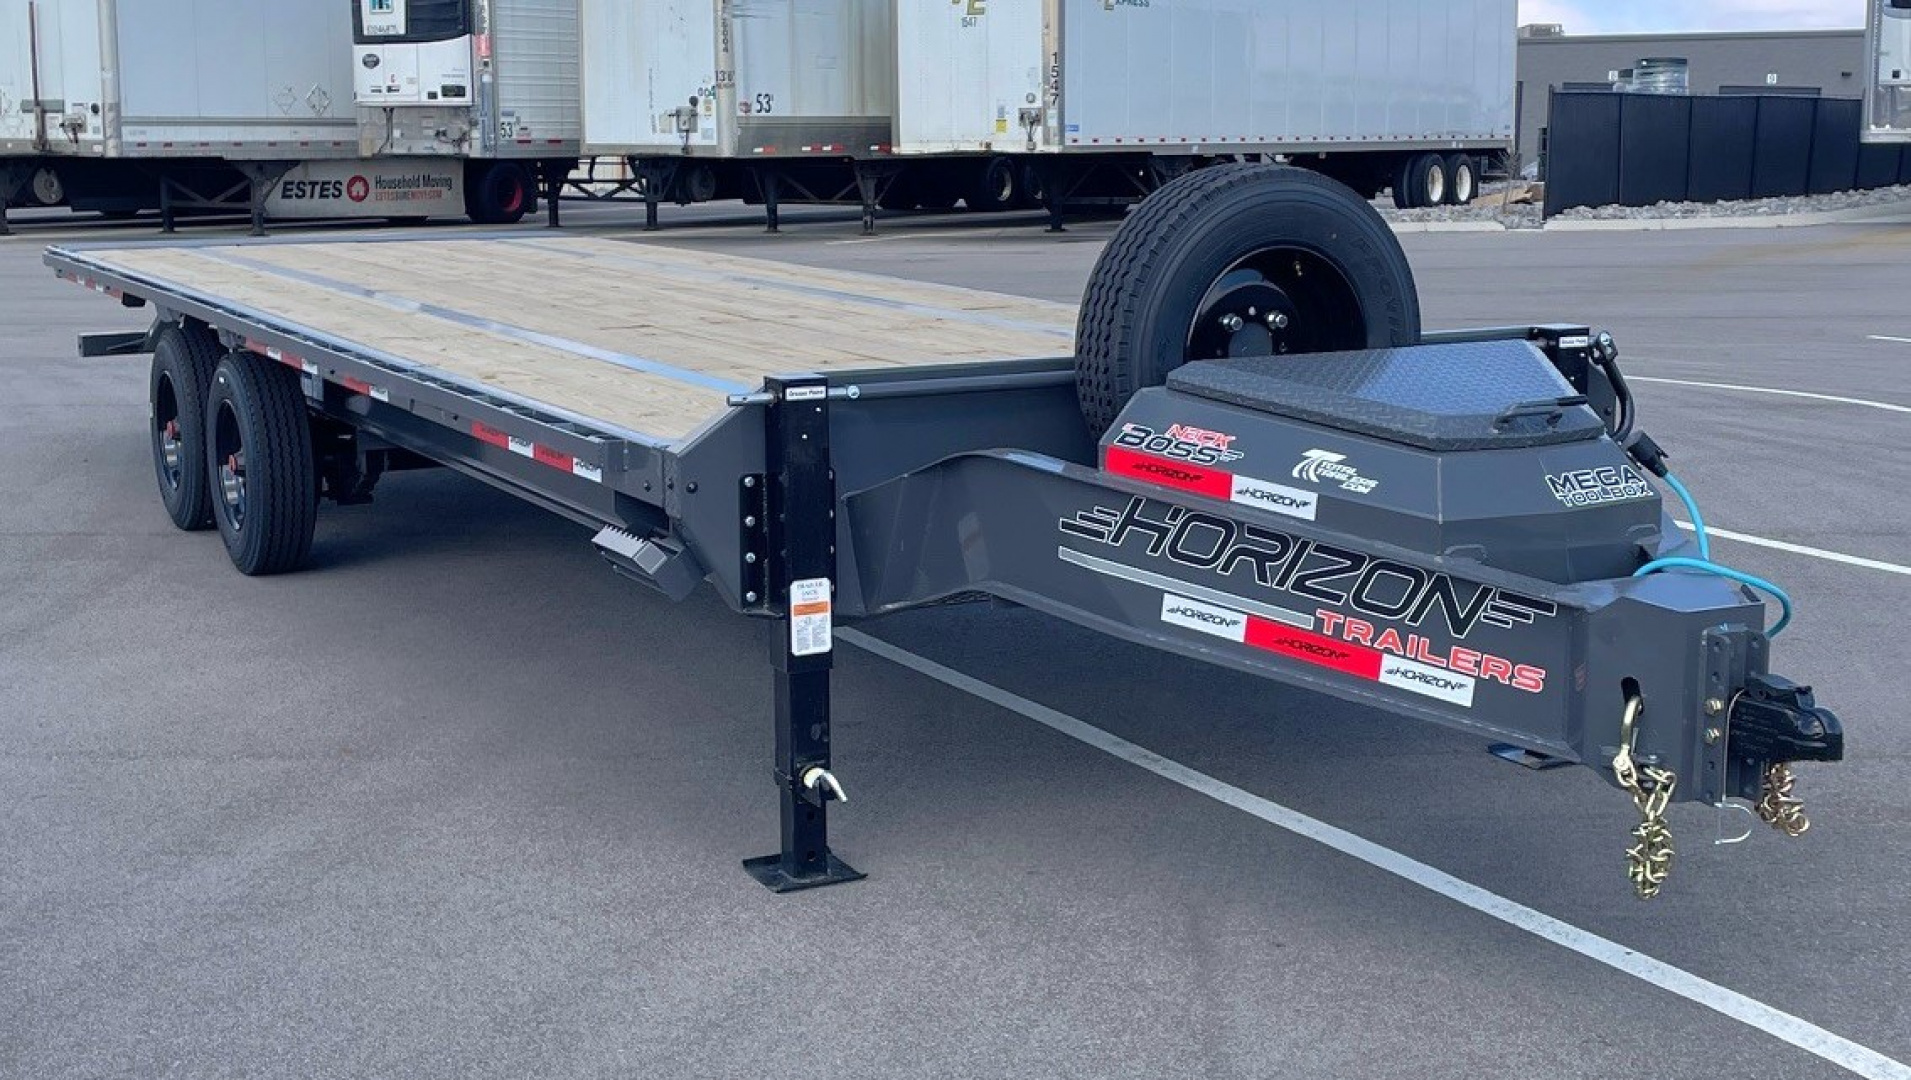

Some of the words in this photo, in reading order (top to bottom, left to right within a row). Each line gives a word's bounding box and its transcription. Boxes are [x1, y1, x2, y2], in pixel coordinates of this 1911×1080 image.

[1050, 52, 1059, 105] 1547
[281, 180, 343, 200] ESTES
[374, 176, 420, 189] Household
[422, 174, 452, 190] Moving
[1113, 422, 1219, 466] BOSS
[1165, 423, 1237, 449] NECK
[1138, 462, 1196, 482] HORIZON
[1545, 464, 1647, 498] MEGA
[1242, 487, 1304, 510] HORIZON
[1557, 480, 1654, 508] TOOLBOX
[1107, 495, 1496, 640] HORIZON
[1173, 603, 1234, 628] HORIZON
[1281, 637, 1342, 661] HORIZON
[1315, 608, 1547, 694] TRAILERS
[1393, 665, 1459, 691] HORIZON
